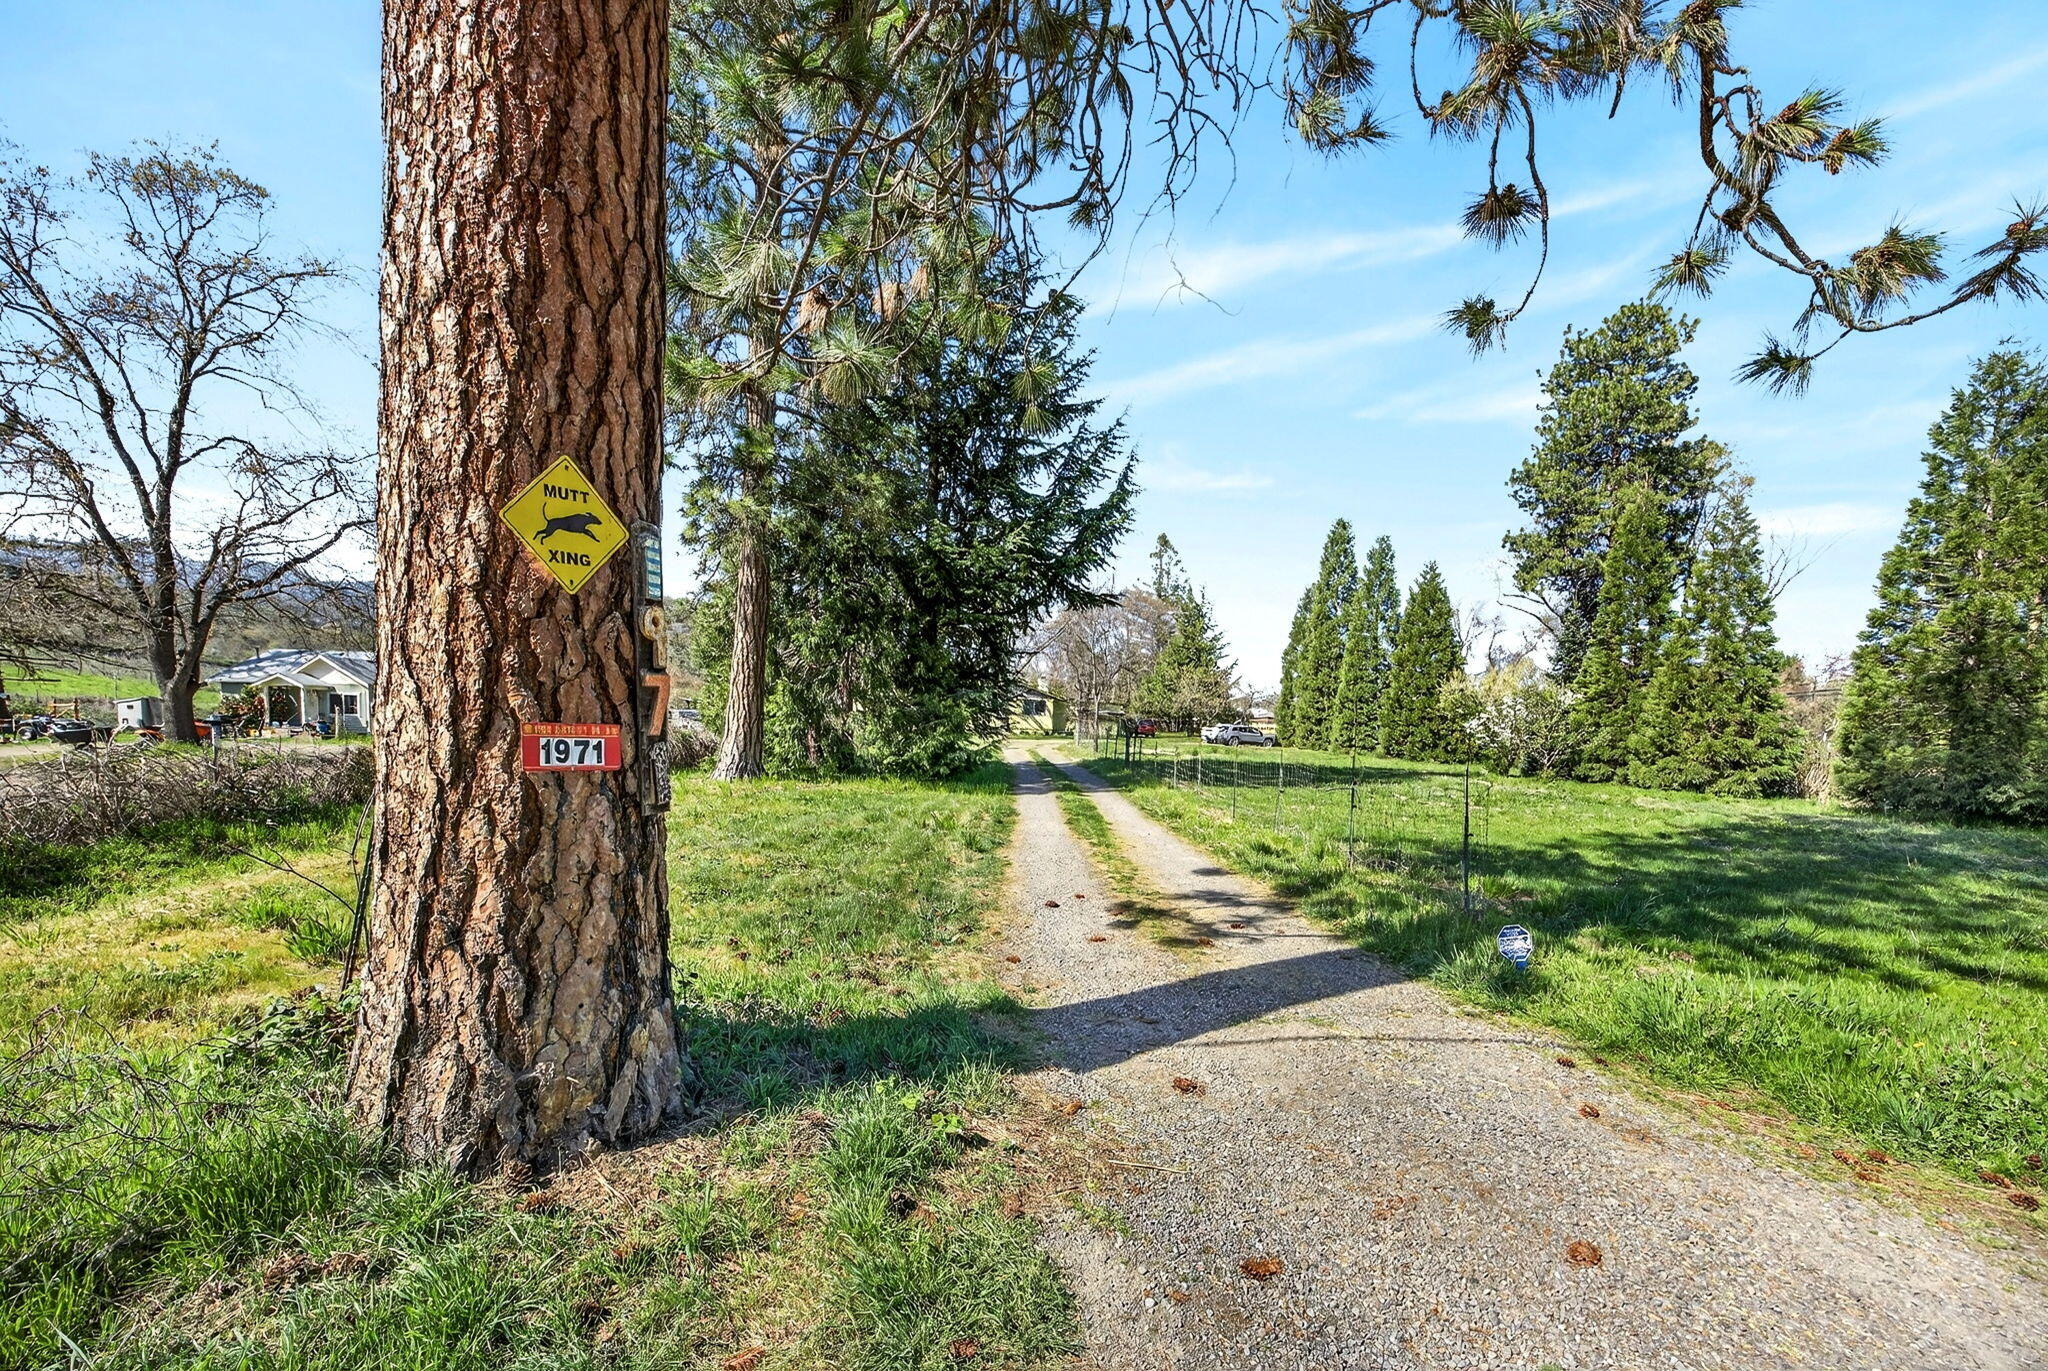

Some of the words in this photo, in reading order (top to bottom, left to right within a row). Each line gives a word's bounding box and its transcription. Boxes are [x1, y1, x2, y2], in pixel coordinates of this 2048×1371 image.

[543, 483, 590, 504] MUTT
[547, 549, 592, 567] XING
[541, 738, 604, 765] 1971
